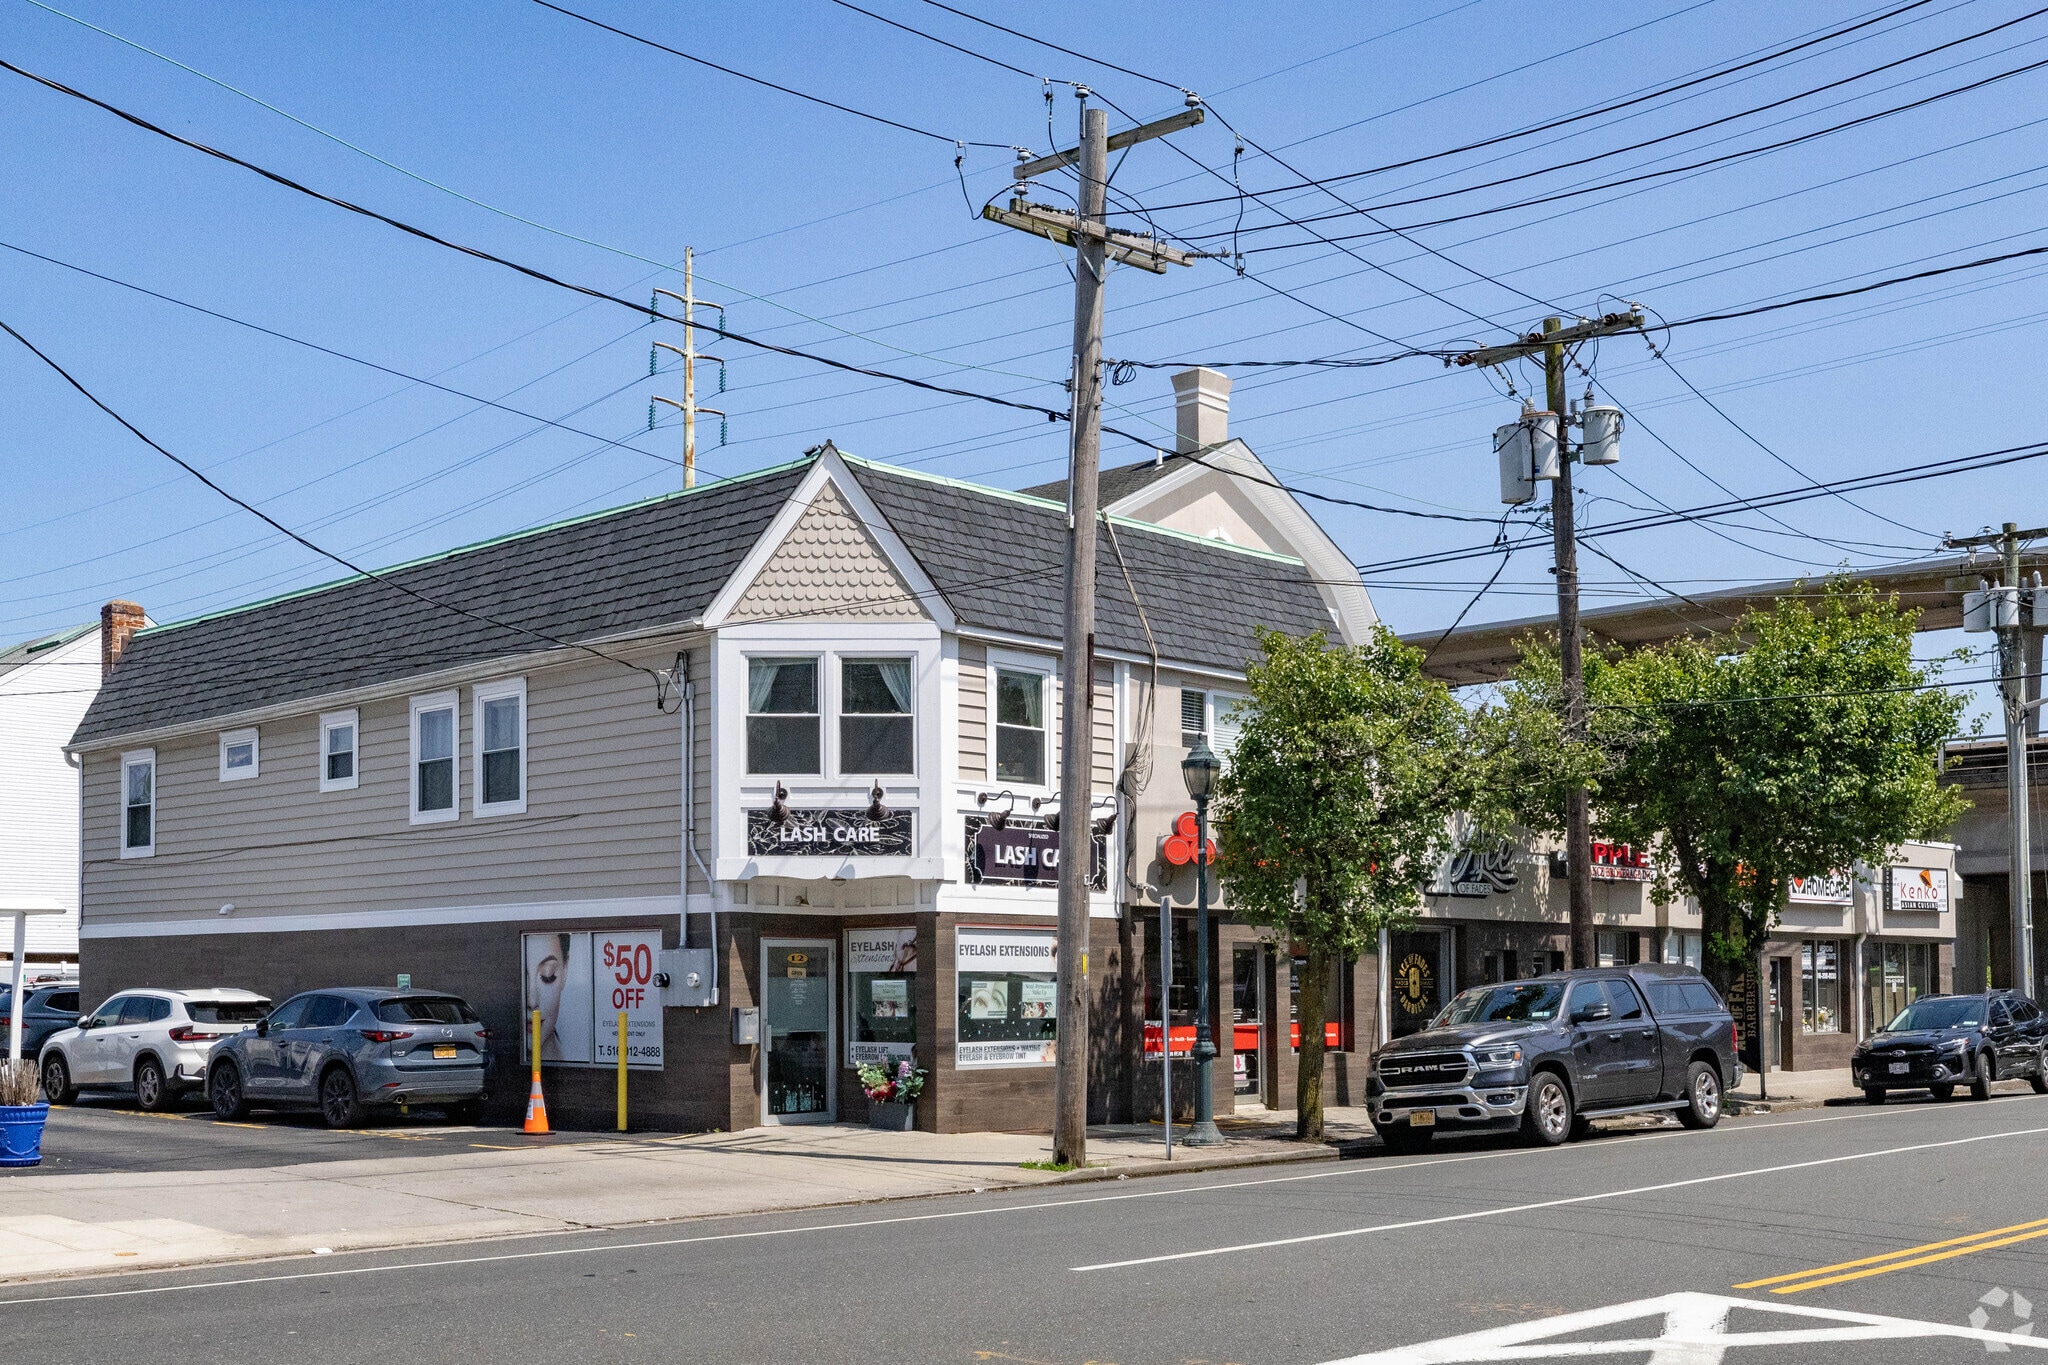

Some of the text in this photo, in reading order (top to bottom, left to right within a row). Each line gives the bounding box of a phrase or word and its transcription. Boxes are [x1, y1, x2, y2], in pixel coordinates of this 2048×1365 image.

[780, 827, 880, 842] LASH CARE
[994, 844, 1037, 866] LASH
[1593, 843, 1650, 868] PPLE
[1460, 884, 1491, 894] OF FADES
[1900, 882, 1938, 900] Kenko
[1901, 901, 1917, 909] ASIAN
[851, 941, 894, 952] EYELASH
[959, 944, 1050, 957] EYELASH EXTENSIONS
[603, 940, 652, 985] $50
[612, 988, 645, 1009] OFF
[856, 1045, 877, 1053] EYELASH
[959, 1046, 982, 1054] EYELASH
[959, 1053, 982, 1061] EYELASH
[1401, 1064, 1438, 1073] RAM
